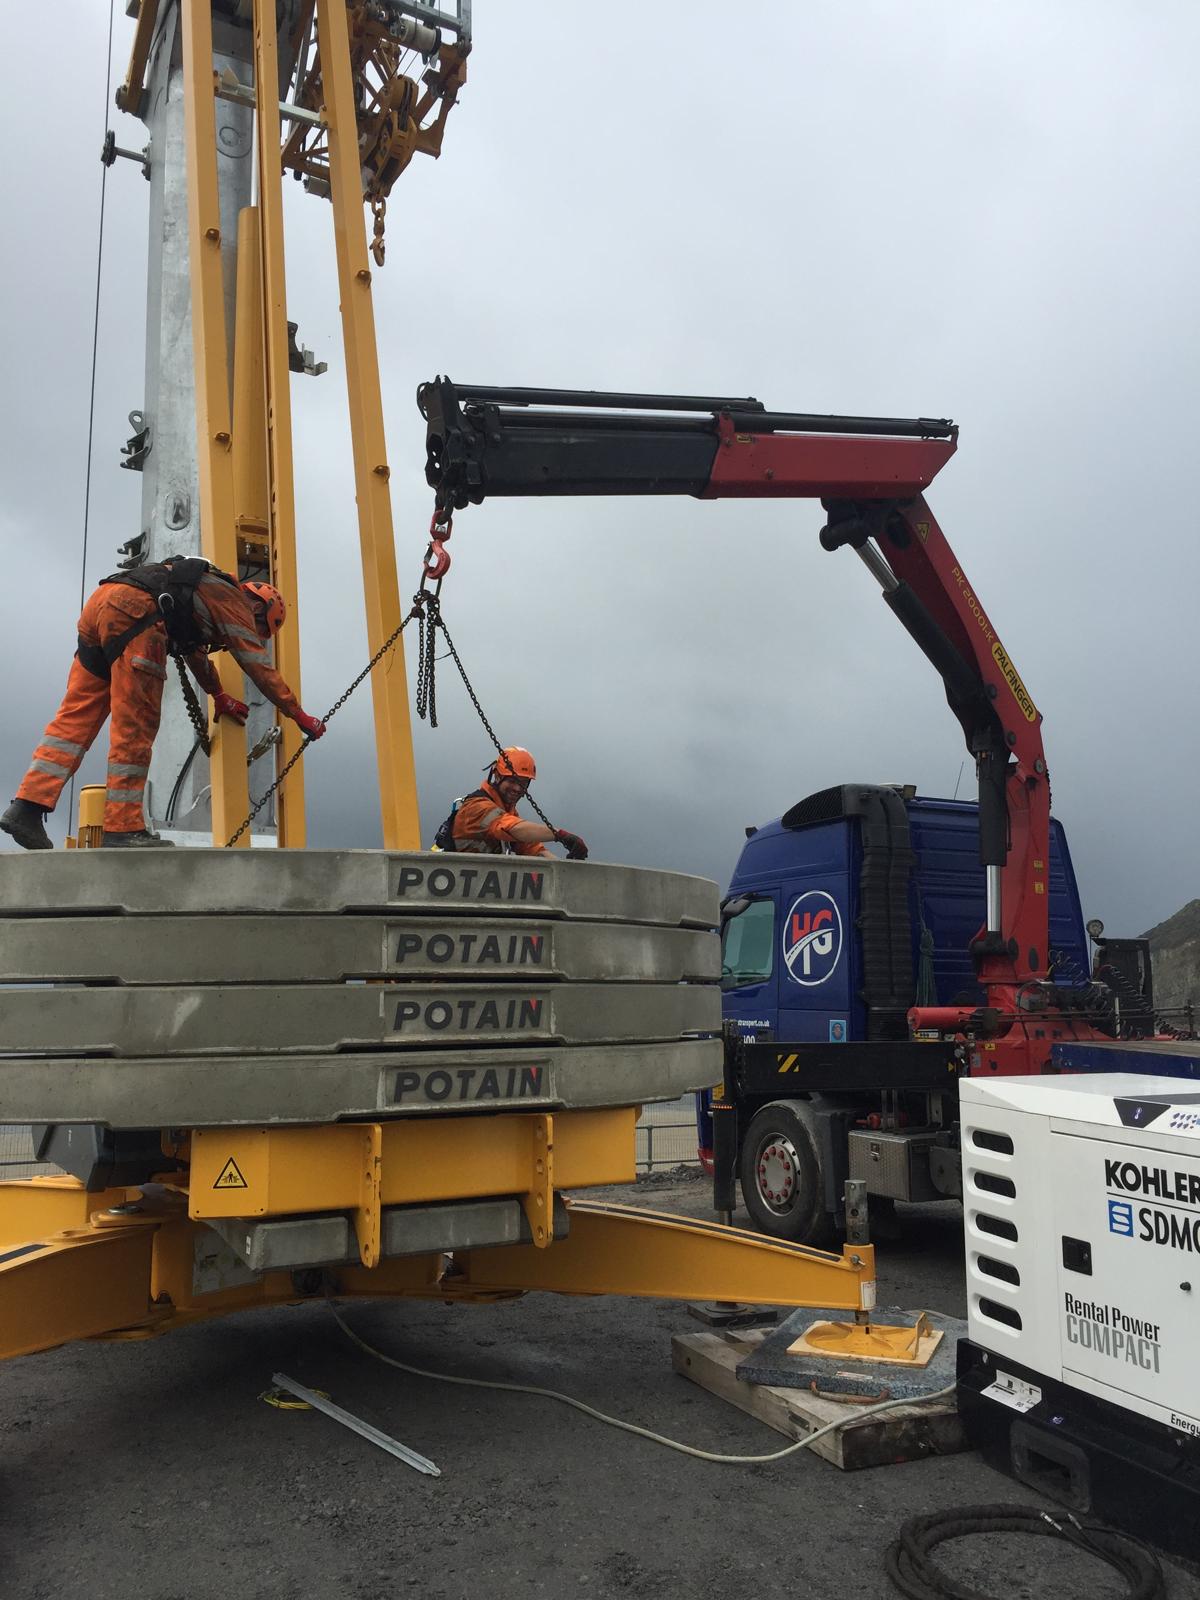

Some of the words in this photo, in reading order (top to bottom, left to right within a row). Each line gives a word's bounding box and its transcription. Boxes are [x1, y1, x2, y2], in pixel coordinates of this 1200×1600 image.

[952, 567, 966, 589] PK
[994, 646, 1034, 719] PALFINGER
[396, 867, 544, 900] POTAIN
[395, 933, 544, 964] POTAIN
[393, 998, 543, 1031] POTAIN
[737, 1019, 770, 1029] transport.co.uk
[394, 1066, 543, 1103] POTAIN
[1104, 1159, 1200, 1204] KOHLER
[1064, 1292, 1109, 1326] Rental
[1112, 1306, 1160, 1342] Power
[1066, 1313, 1161, 1374] COMPACT
